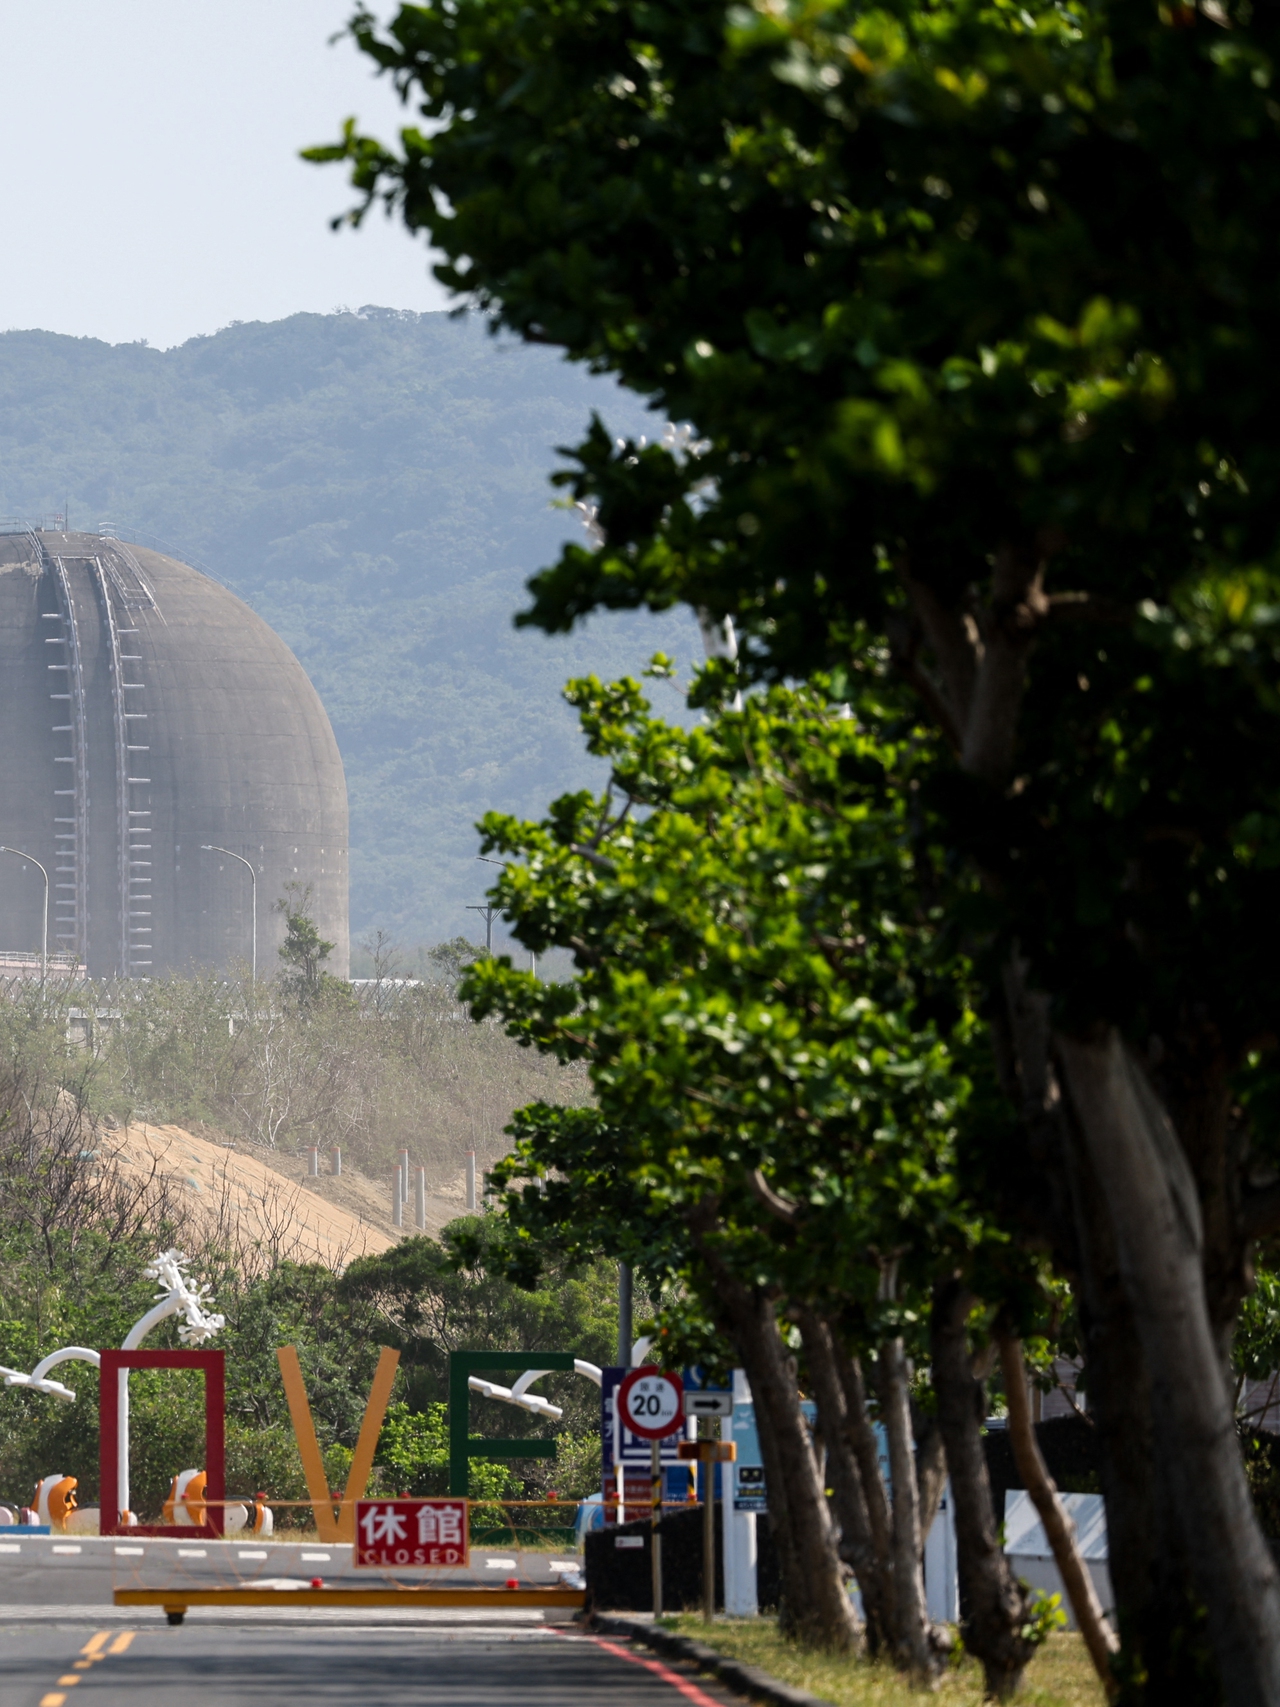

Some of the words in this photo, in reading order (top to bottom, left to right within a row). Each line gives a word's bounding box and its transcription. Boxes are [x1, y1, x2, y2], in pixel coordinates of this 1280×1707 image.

[640, 1382, 664, 1392] 限速
[633, 1394, 661, 1417] 20
[360, 1505, 462, 1546] 休館
[363, 1548, 460, 1565] CLOSED
